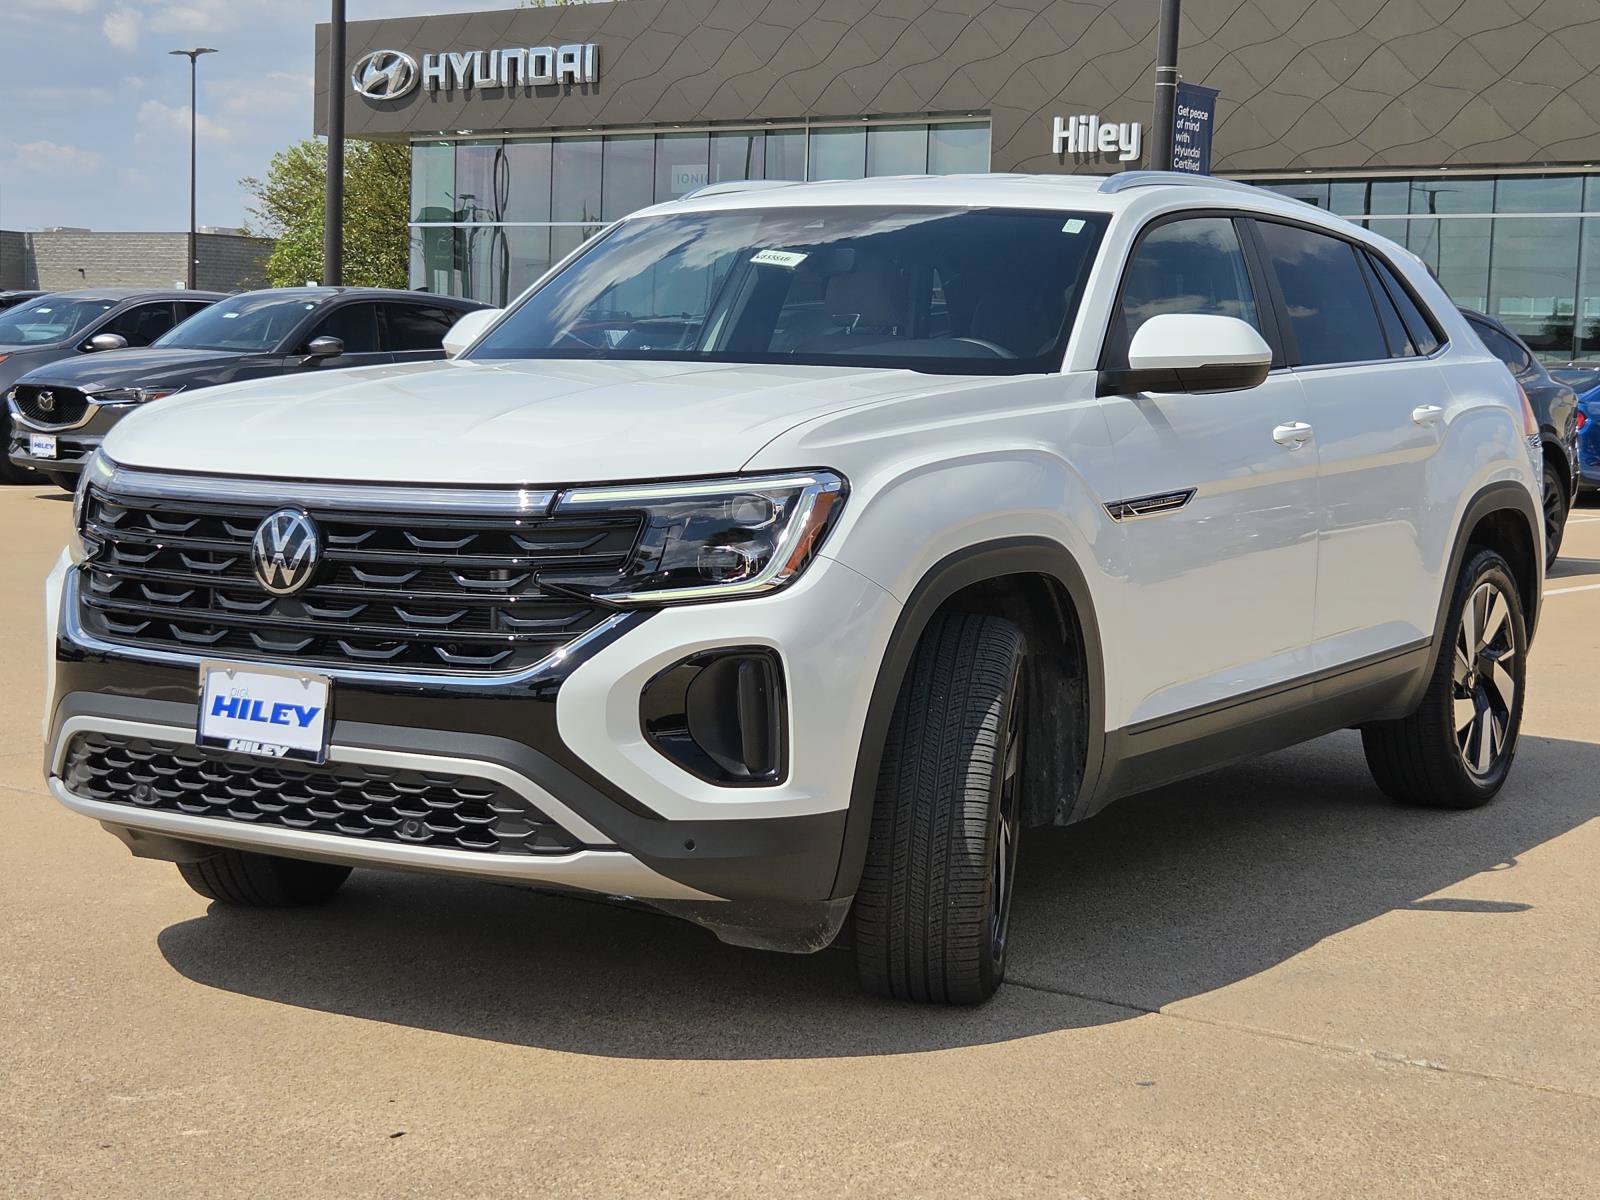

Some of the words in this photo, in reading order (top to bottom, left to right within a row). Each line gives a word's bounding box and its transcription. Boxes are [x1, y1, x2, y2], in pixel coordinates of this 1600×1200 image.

[424, 44, 599, 90] HYUNDAI
[1178, 105, 1189, 117] Get
[1189, 108, 1208, 121] peace
[1177, 118, 1184, 128] of
[1184, 120, 1200, 132] mind
[1053, 115, 1142, 161] Hiley
[1175, 132, 1190, 144] with
[1174, 146, 1201, 159] Hyundai
[1173, 158, 1200, 171] Certified
[34, 442, 55, 450] HILEY
[211, 695, 321, 728] HILEY
[228, 738, 290, 757] HILEY
